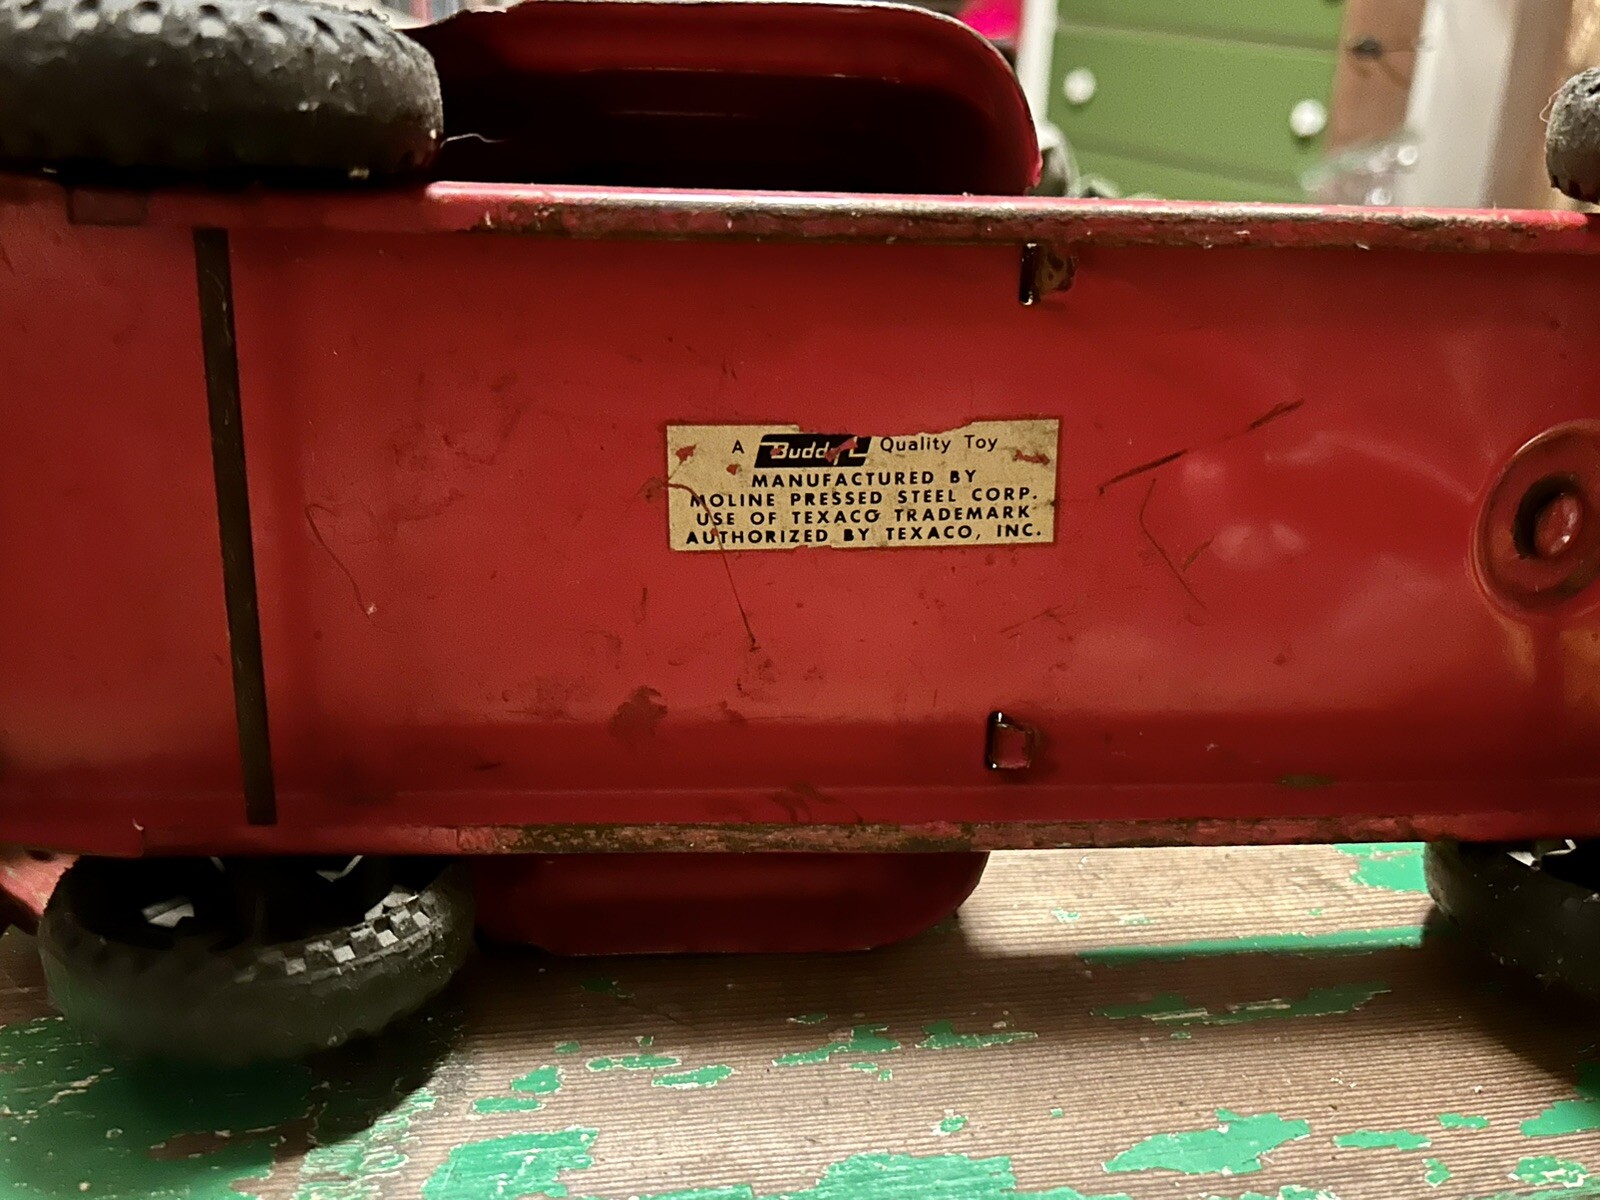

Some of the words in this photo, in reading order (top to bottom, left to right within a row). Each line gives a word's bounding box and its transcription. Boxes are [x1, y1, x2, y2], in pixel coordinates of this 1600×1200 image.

[731, 439, 745, 455] A
[880, 436, 951, 454] Quality
[964, 434, 998, 452] Toy
[751, 470, 935, 488] MANUFACTURED
[950, 469, 977, 484] BY
[689, 493, 776, 507] MOLINE
[790, 490, 883, 506] PRESSED
[897, 488, 957, 503] STEEL
[971, 486, 1038, 501] CORP.
[696, 511, 736, 526] USE
[750, 511, 777, 525] OF
[791, 508, 881, 525] TEXACO
[894, 505, 1030, 522] TRADEMARK
[685, 529, 829, 545] AUTHORIZED
[843, 527, 869, 542] BY
[885, 524, 981, 541] TEXACO,
[996, 522, 1042, 538] INC.
